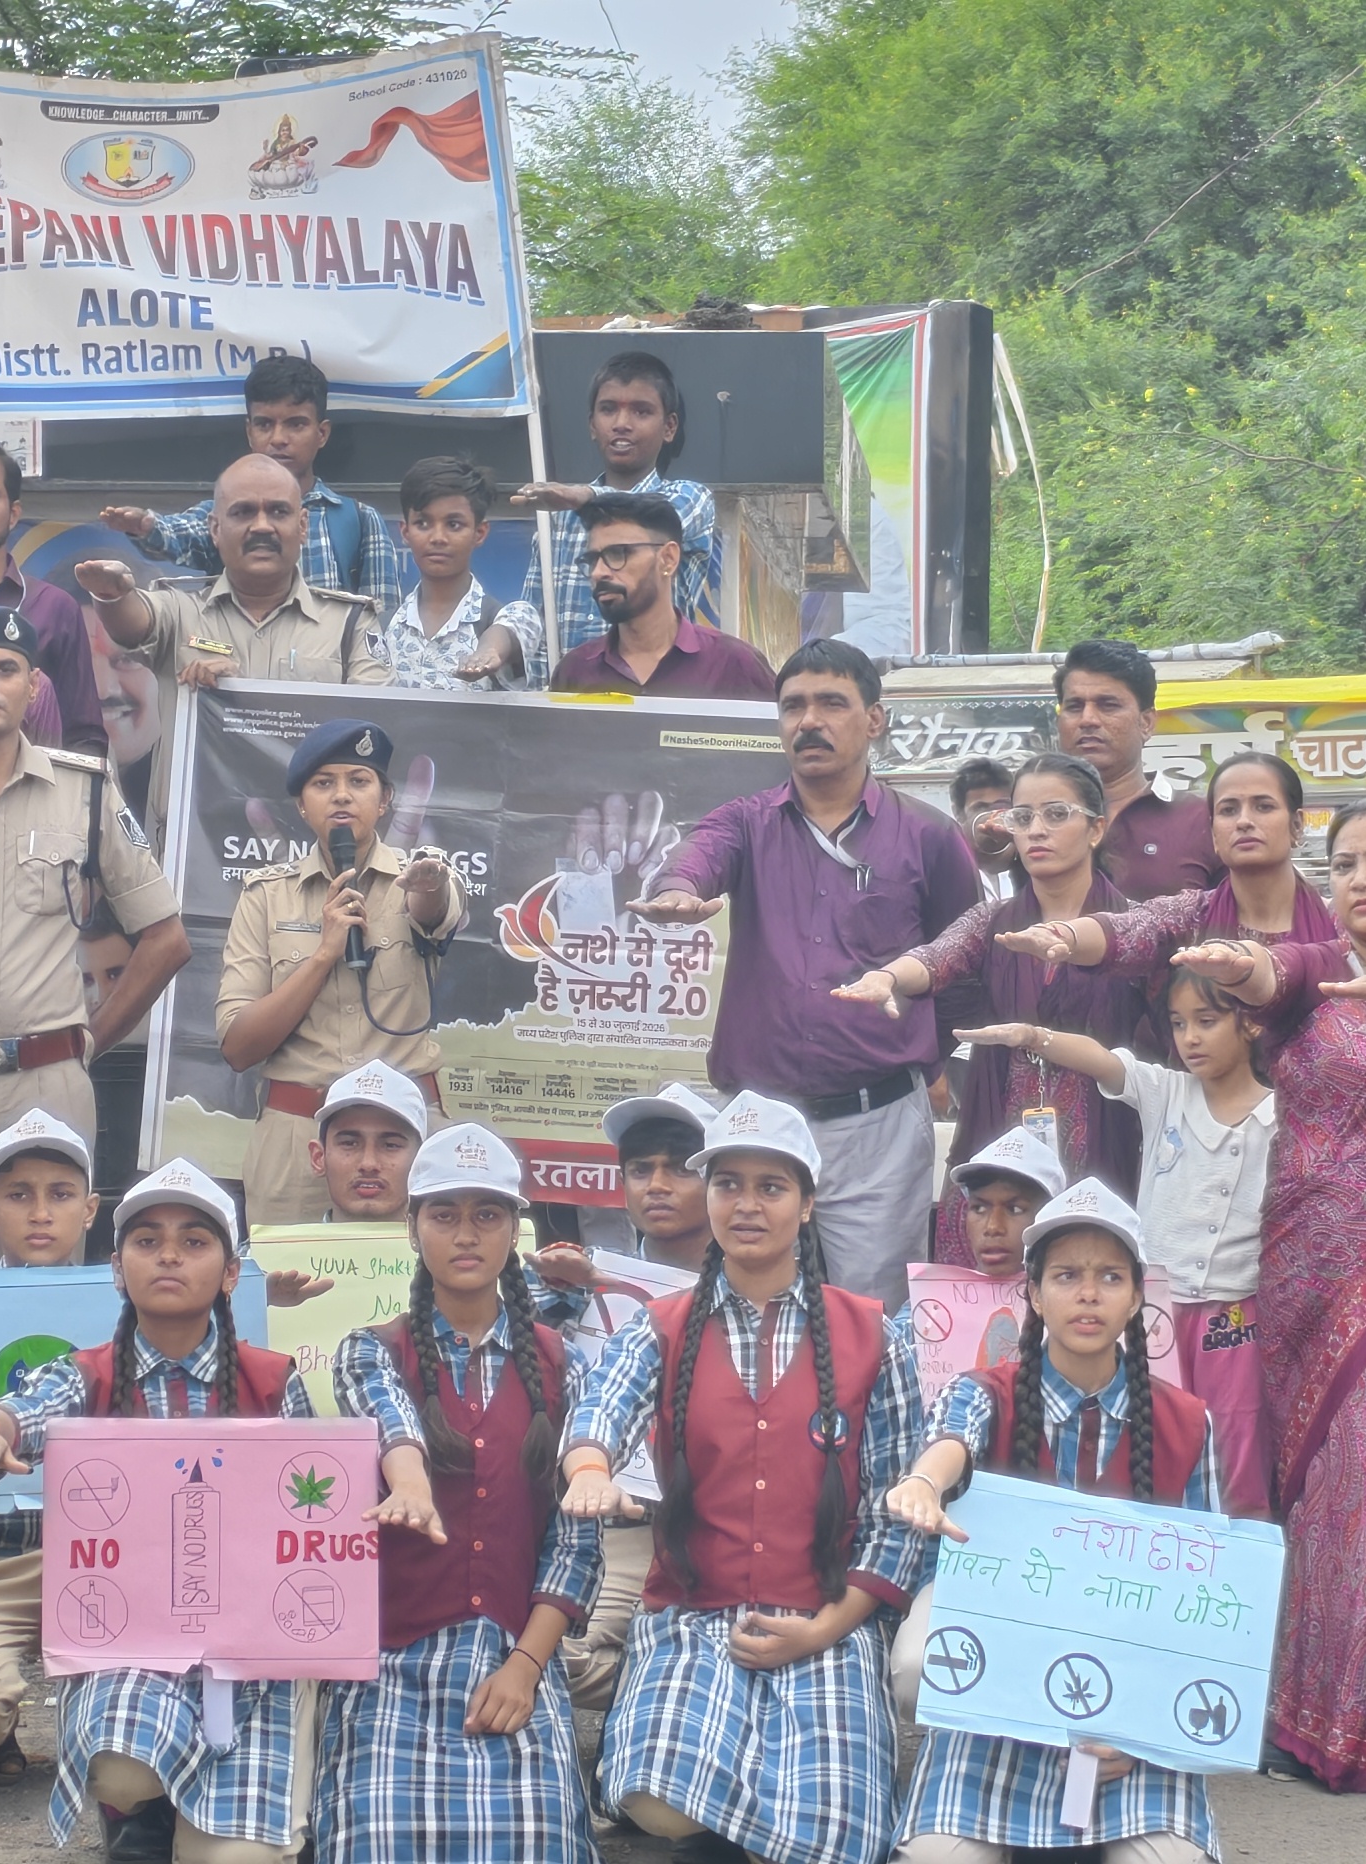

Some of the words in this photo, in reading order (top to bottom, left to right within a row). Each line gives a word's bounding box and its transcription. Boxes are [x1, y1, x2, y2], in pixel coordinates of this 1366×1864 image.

[348, 84, 386, 101] School
[388, 78, 416, 93] Code
[141, 213, 485, 306] VIDHYALAYA
[77, 288, 214, 331] ALOTE
[81, 339, 202, 376] Ratlam
[663, 735, 782, 749] #NasheSeDooriHaiZaroor
[224, 836, 280, 861] SAY
[560, 925, 619, 966] नशे
[625, 928, 657, 967] से
[662, 930, 713, 984] दूरी
[538, 963, 561, 1012] है
[657, 984, 707, 1016] 2.0
[449, 1081, 473, 1092] 1933
[491, 1084, 523, 1095] 14416
[541, 1087, 575, 1099] 14446
[531, 1160, 621, 1191] रतला
[310, 1256, 359, 1281] YUVA
[952, 1282, 979, 1305] NO
[184, 1491, 207, 1540] DRUGS
[69, 1538, 120, 1569] NO
[276, 1530, 379, 1564] DRUGS
[182, 1542, 207, 1569] NO
[1052, 1517, 1143, 1562] नशा
[181, 1572, 210, 1605] SAY
[1021, 1547, 1066, 1597] से
[1083, 1573, 1162, 1612] नाता
